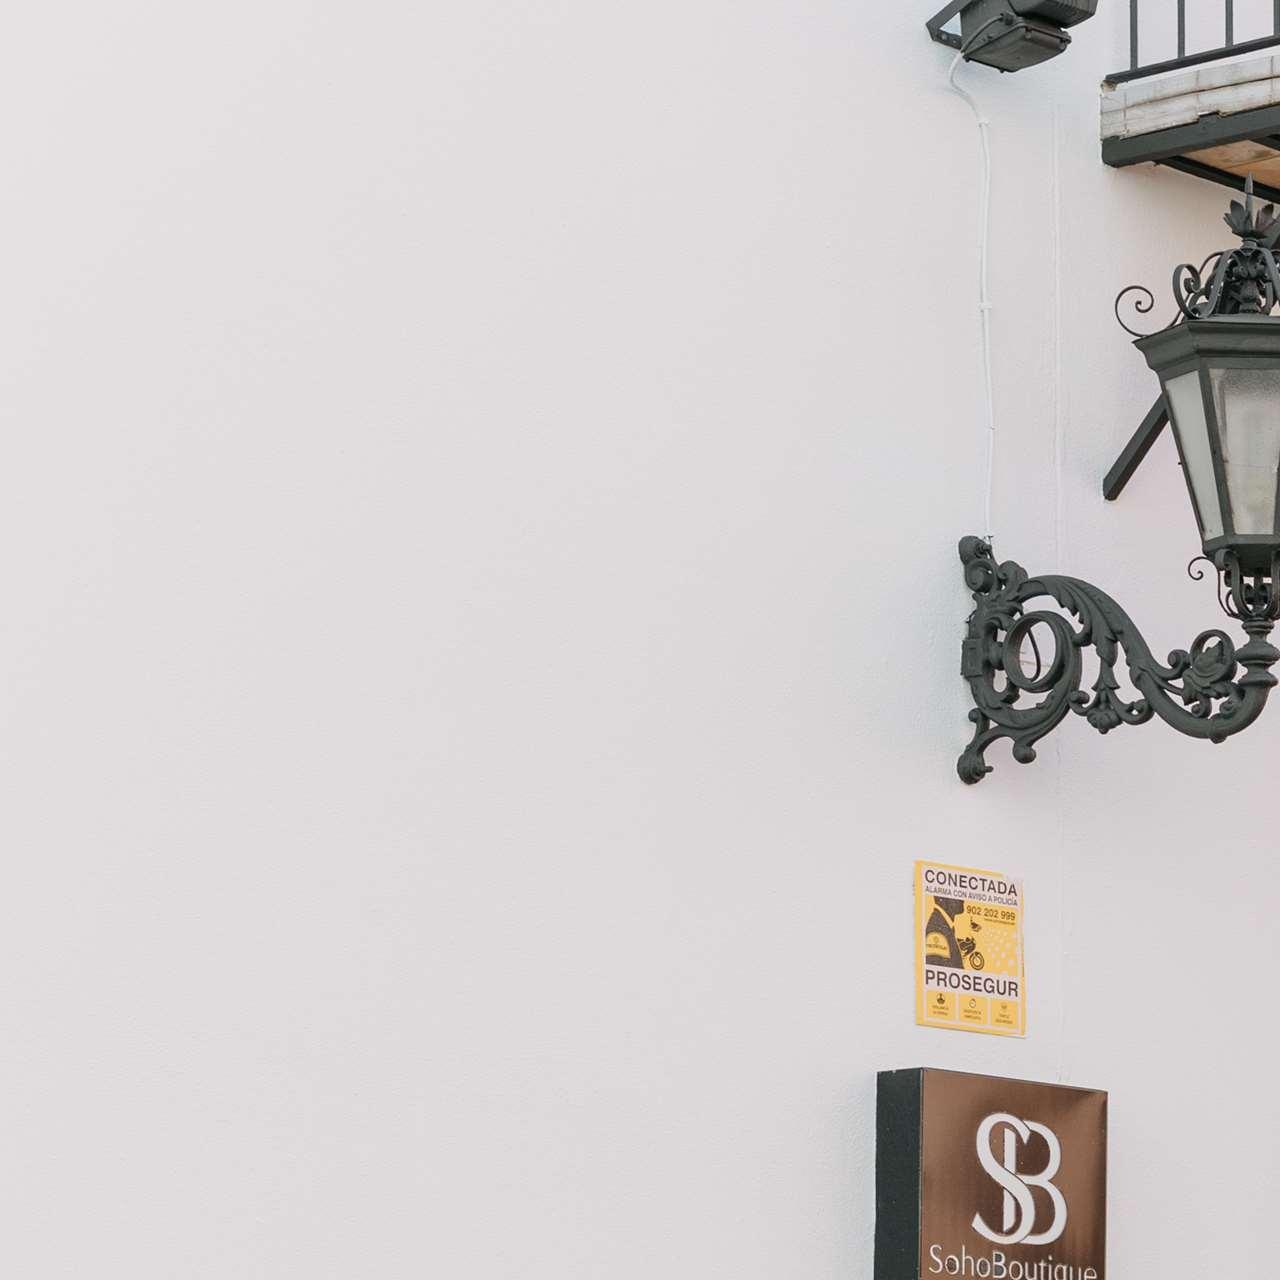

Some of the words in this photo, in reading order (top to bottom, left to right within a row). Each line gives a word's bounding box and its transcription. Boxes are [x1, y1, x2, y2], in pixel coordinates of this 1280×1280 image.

[925, 870, 1018, 897] CONECTADA
[925, 886, 952, 896] ALARMA
[953, 891, 967, 899] CON
[968, 893, 987, 903] AVISO
[966, 905, 981, 916] 902
[984, 907, 999, 918] 202
[925, 969, 1019, 998] PROSEGUR
